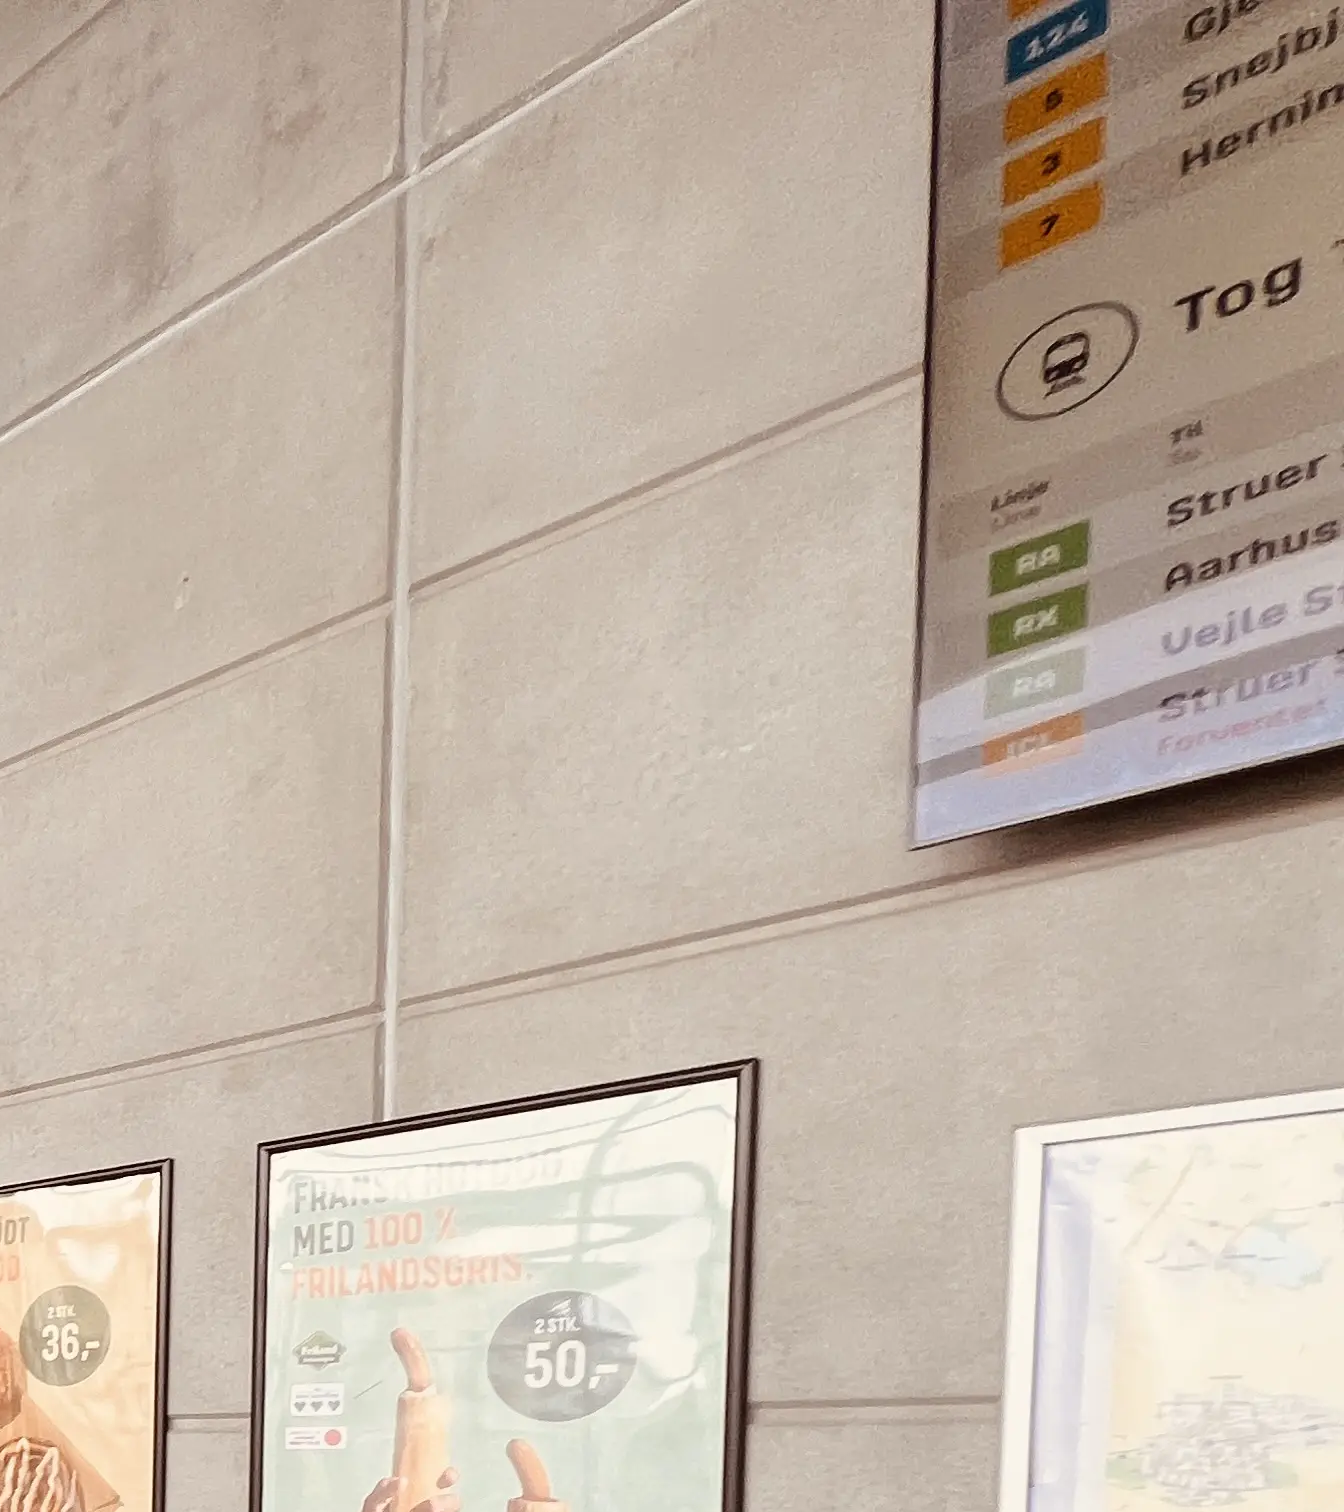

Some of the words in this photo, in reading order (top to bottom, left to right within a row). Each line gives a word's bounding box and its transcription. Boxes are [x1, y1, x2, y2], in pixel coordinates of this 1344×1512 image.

[1040, 151, 1062, 177] 3
[1040, 213, 1061, 238] 7
[1174, 256, 1303, 333] Tog
[1166, 452, 1330, 529] Struer
[1164, 518, 1341, 595] Aarhus
[292, 1219, 355, 1258] MED
[364, 1210, 424, 1250] 100
[434, 1205, 459, 1244] %
[533, 1318, 545, 1335] 2
[523, 1339, 620, 1390] 50,-
